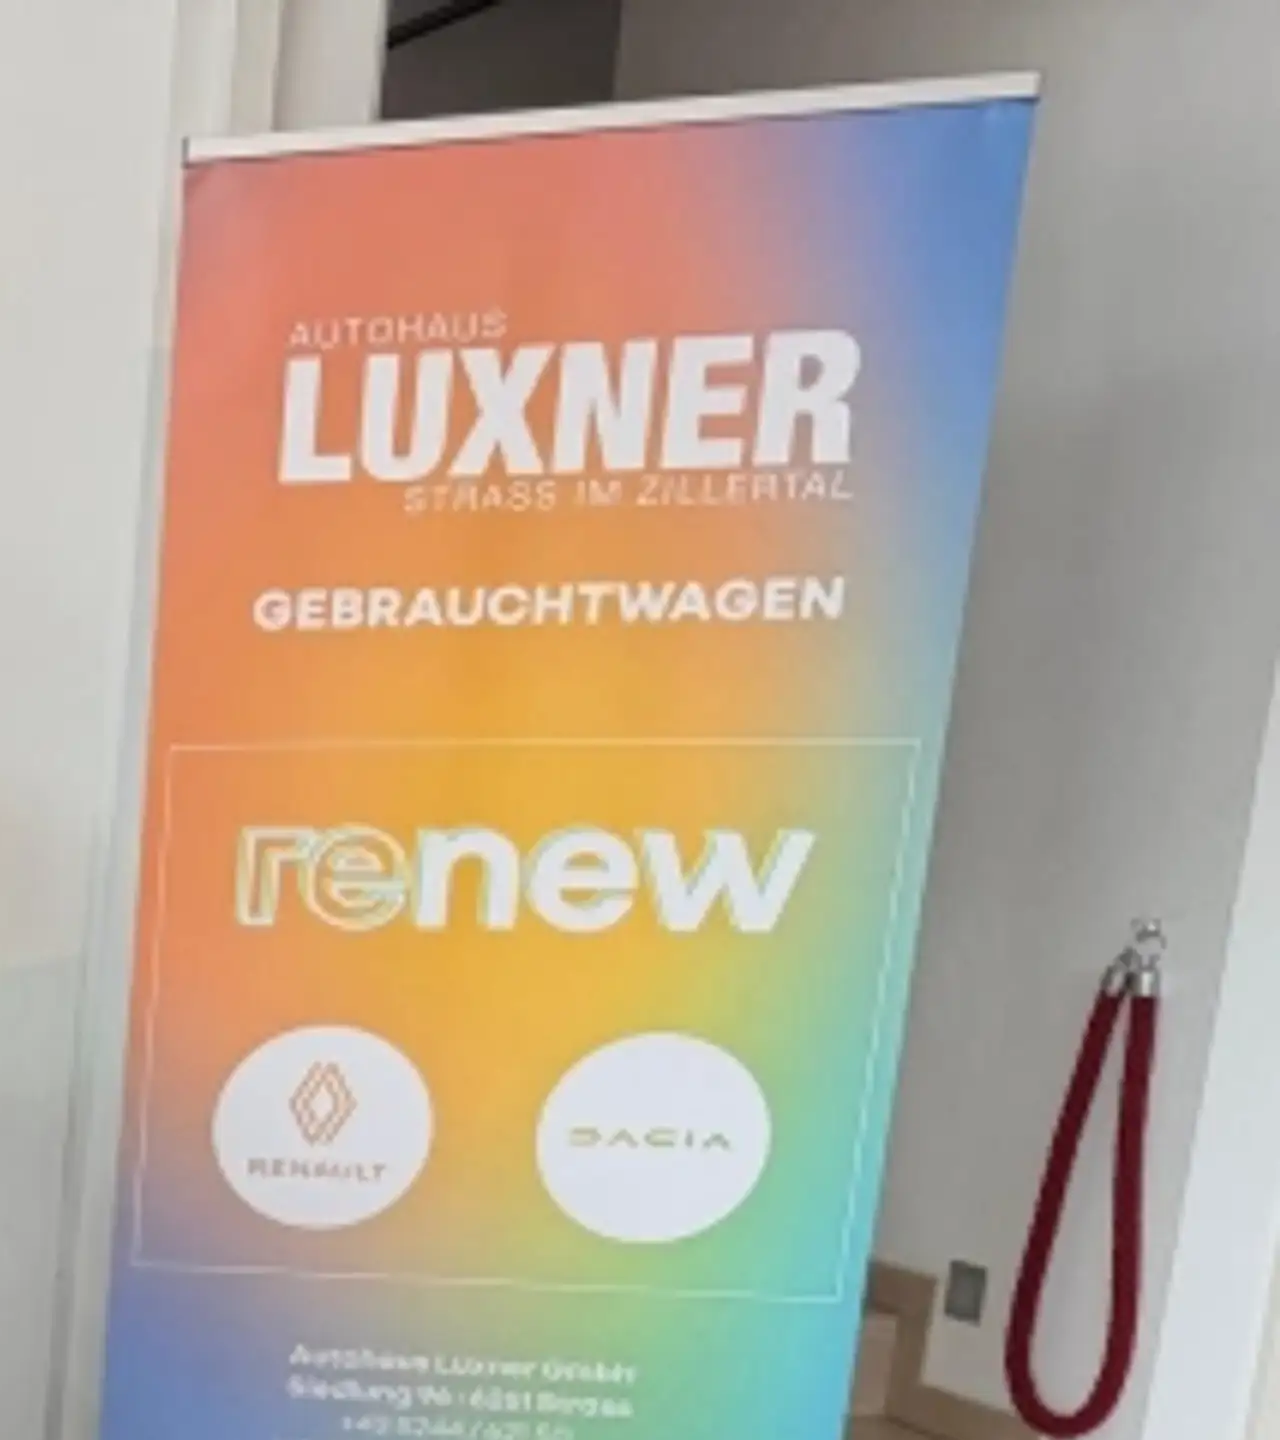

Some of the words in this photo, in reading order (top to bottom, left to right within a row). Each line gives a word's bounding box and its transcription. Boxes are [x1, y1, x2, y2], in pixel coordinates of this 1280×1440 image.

[288, 308, 507, 350] AUTOHAUS
[277, 329, 862, 487] LUXNER
[402, 480, 558, 515] STRASS
[576, 478, 624, 508] IM
[636, 470, 856, 507] ZILLERTAL
[252, 576, 846, 634] GEBRAUCHTWAGEN
[234, 824, 815, 933] renew
[570, 1126, 734, 1153] DACIA
[246, 1156, 387, 1183] RENAULT
